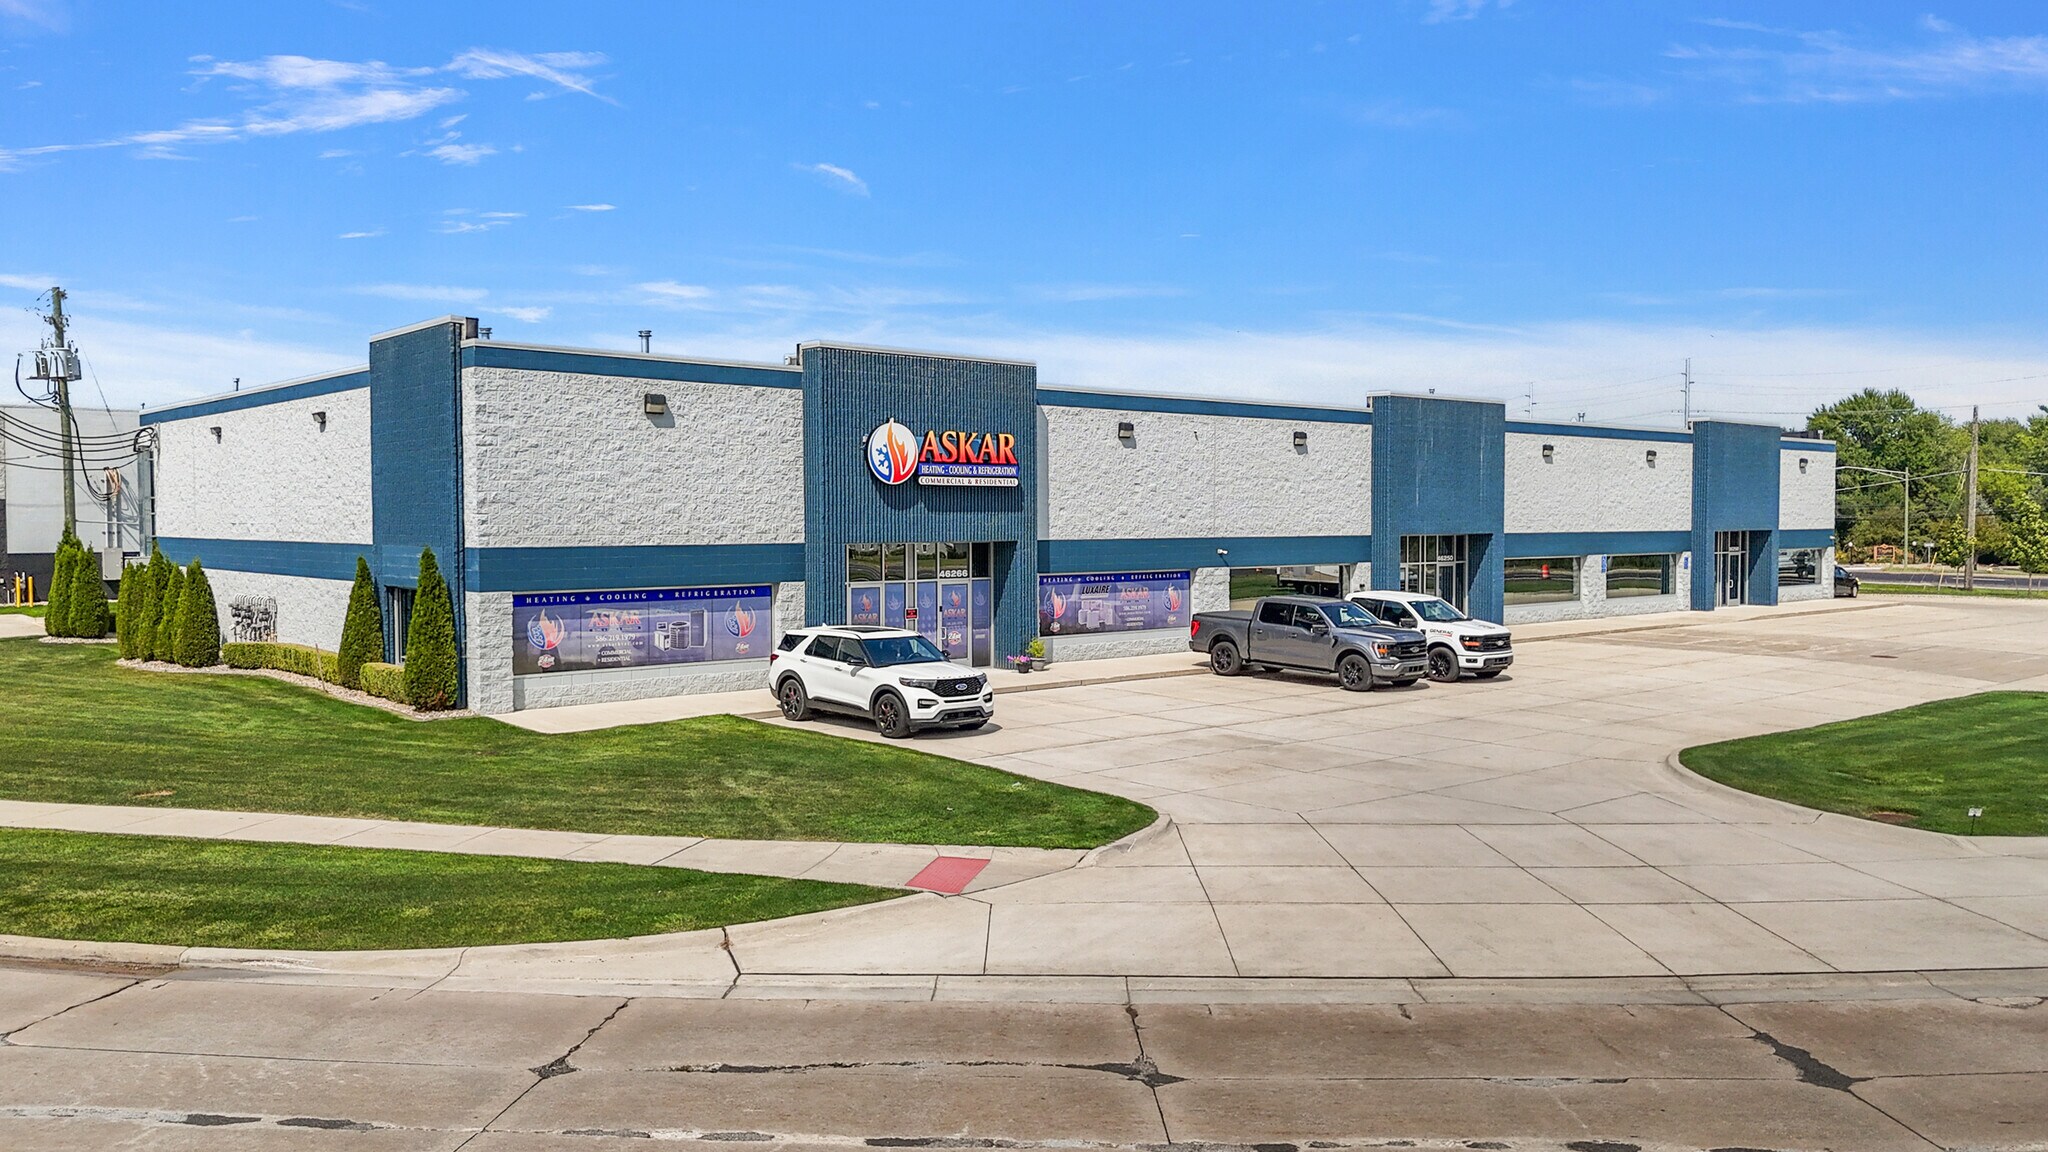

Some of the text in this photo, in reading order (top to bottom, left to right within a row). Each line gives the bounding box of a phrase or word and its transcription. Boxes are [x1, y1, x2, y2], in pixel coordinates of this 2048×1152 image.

[919, 430, 1017, 464] ASKAR
[921, 465, 945, 474] HEATING
[948, 465, 972, 475] COOLING
[978, 466, 1016, 476] REFRIGERATION
[939, 569, 968, 578] 46266
[1082, 585, 1110, 594] LUXAIRE
[526, 589, 756, 604] HEATING COOLING REFRIGERATION
[588, 609, 641, 628] ASKAR
